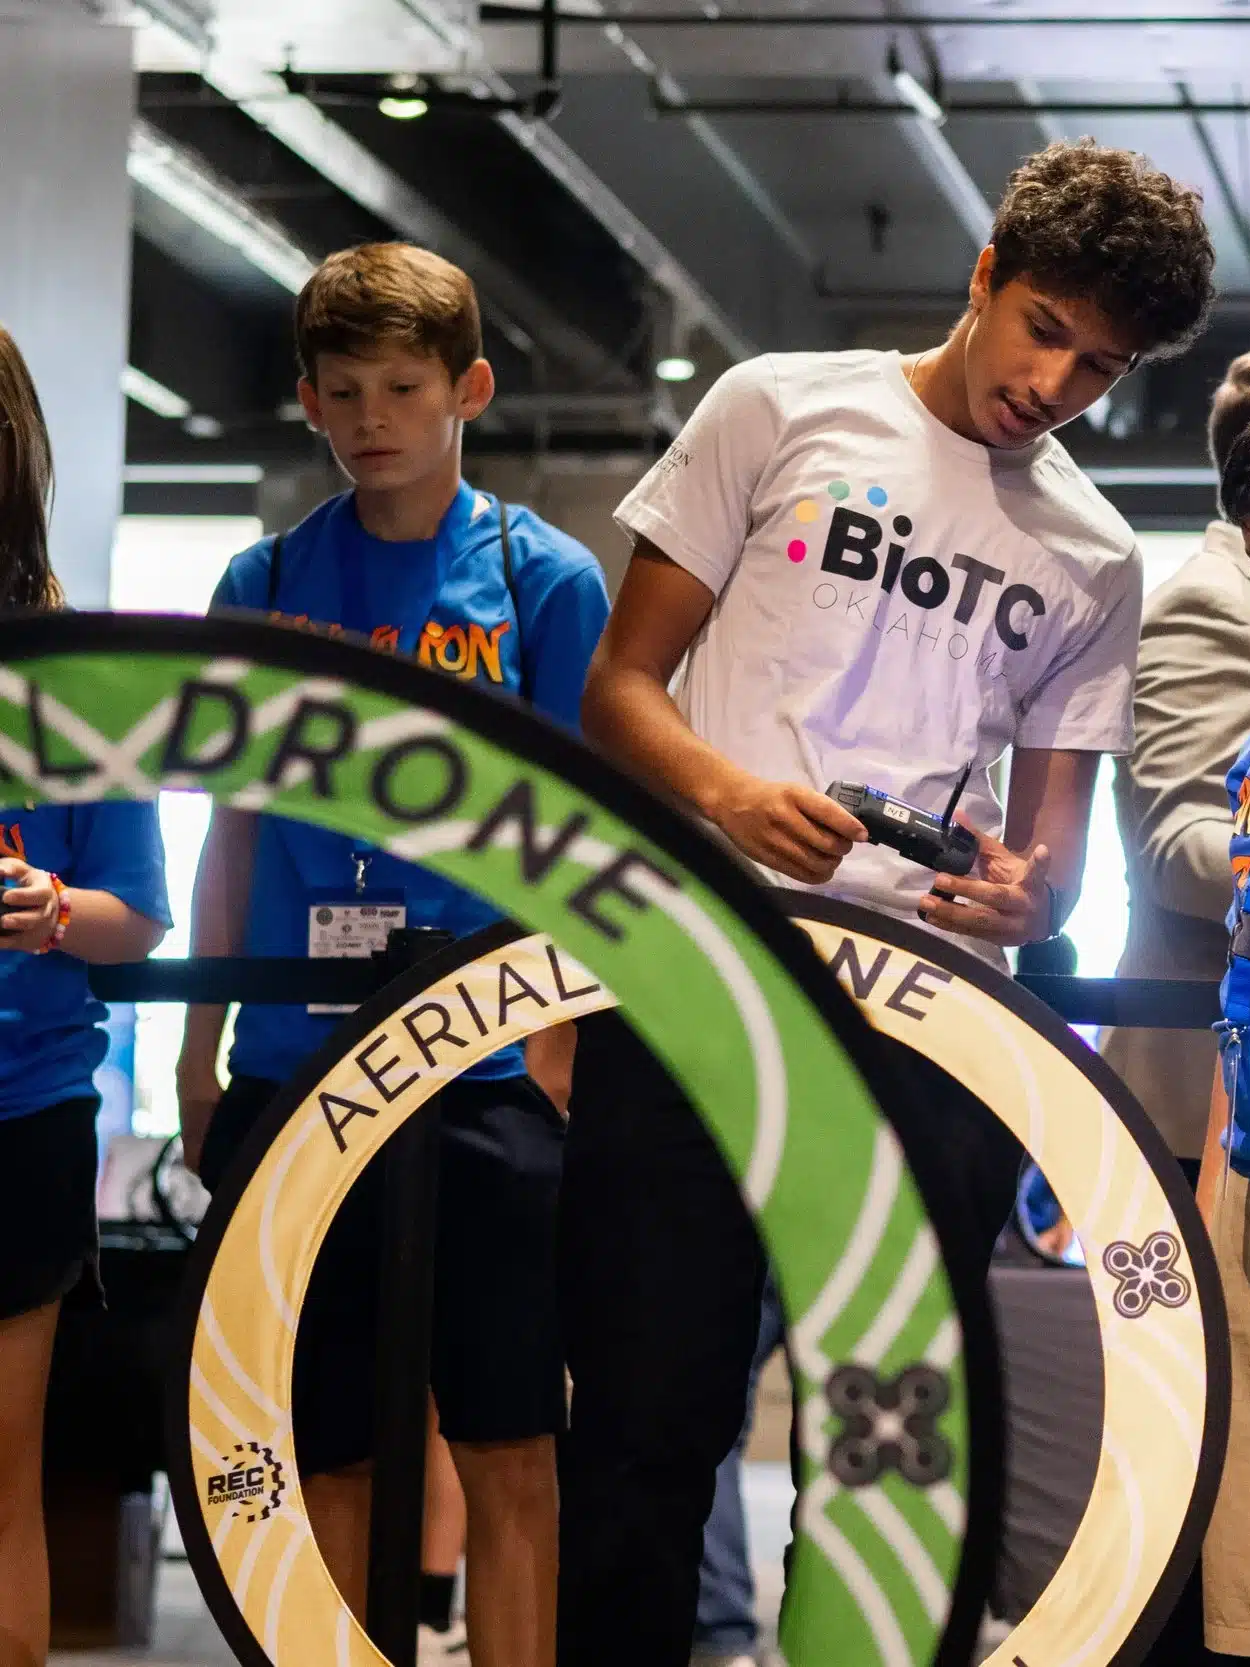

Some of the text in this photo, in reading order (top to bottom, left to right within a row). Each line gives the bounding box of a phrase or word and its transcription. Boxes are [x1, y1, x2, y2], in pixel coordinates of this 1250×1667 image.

[820, 506, 1046, 652] BioTC
[161, 676, 682, 945] DRONE
[318, 943, 601, 1154] AERIAL
[207, 1485, 264, 1506] FOUNDATION
